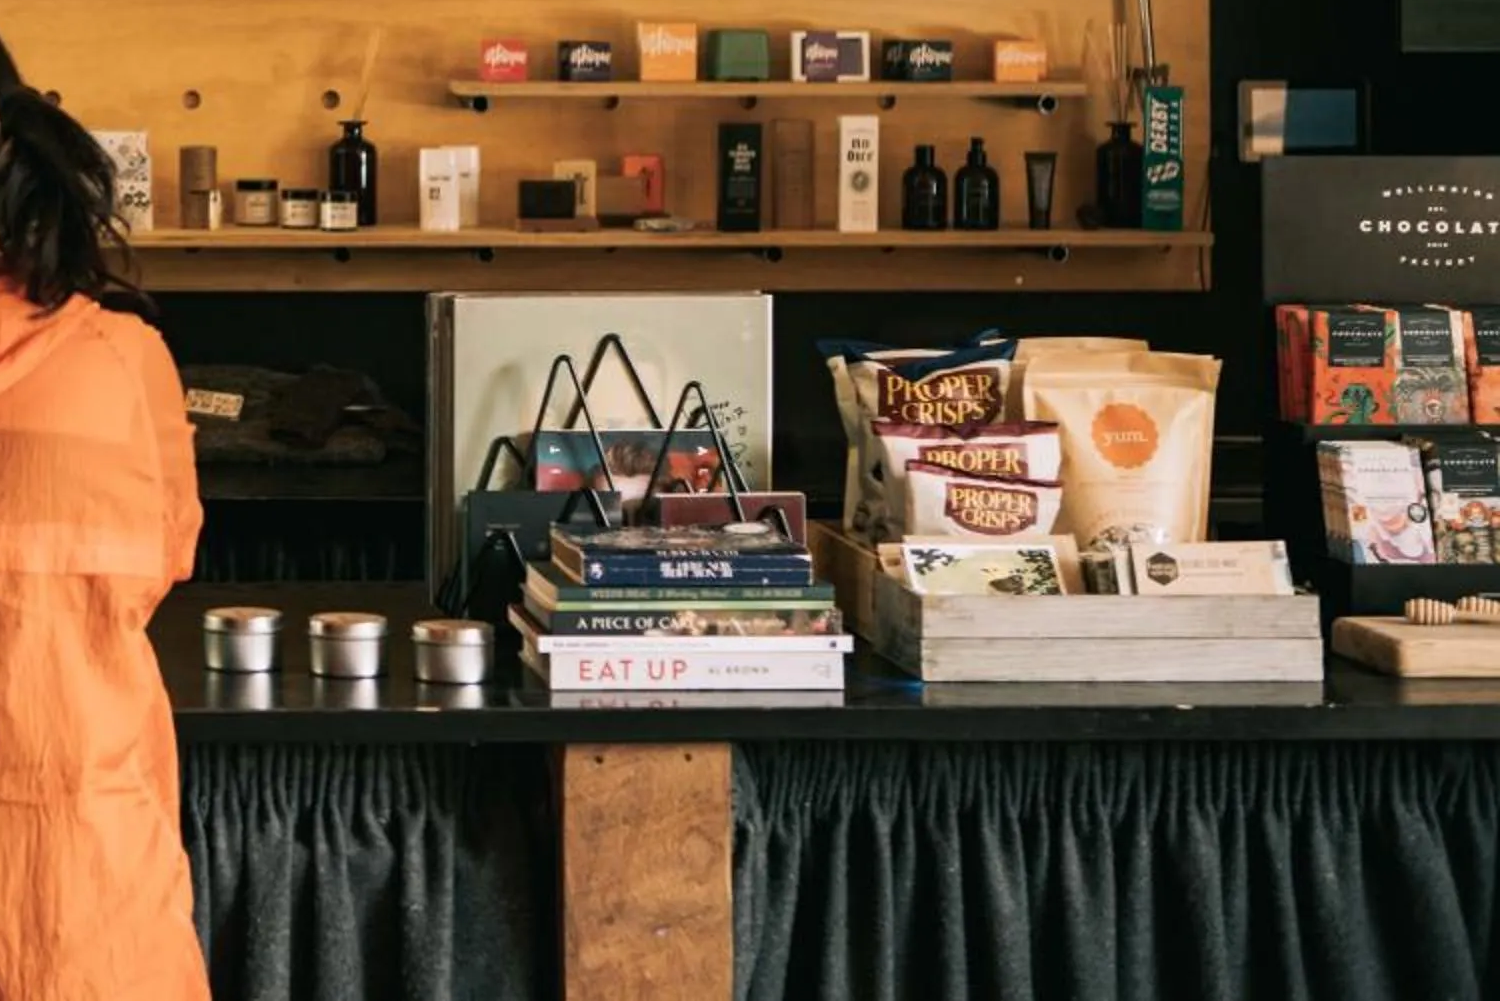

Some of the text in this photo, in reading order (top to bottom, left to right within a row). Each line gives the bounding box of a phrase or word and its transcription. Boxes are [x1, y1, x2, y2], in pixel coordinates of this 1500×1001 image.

[1151, 99, 1168, 152] DERBY
[887, 374, 997, 405] PROPER
[1102, 430, 1149, 447] yum.
[951, 487, 1033, 517] PROPER
[577, 617, 588, 629] A
[592, 616, 631, 629] PIECE
[579, 659, 633, 682] EAT
[648, 659, 688, 680] UP
